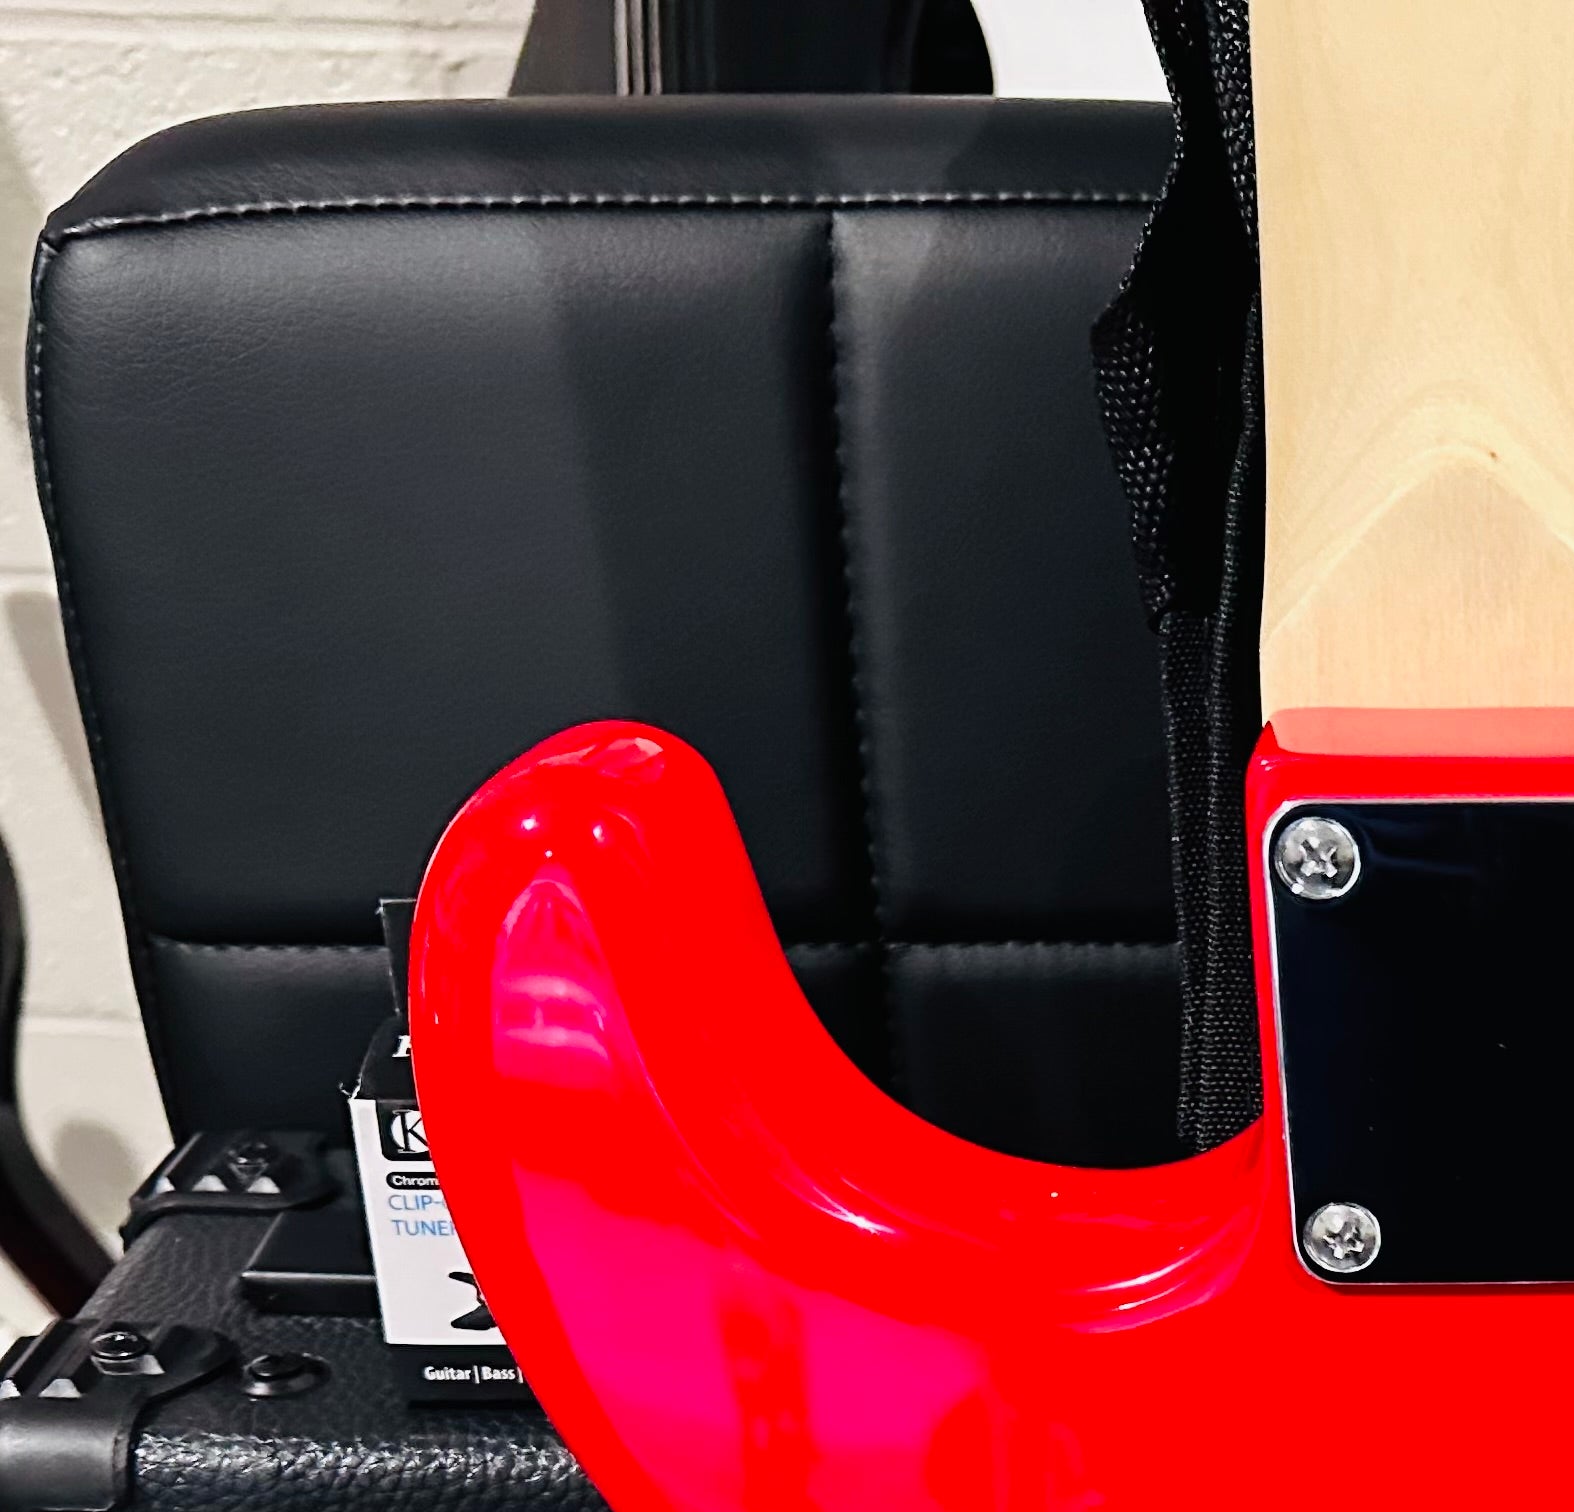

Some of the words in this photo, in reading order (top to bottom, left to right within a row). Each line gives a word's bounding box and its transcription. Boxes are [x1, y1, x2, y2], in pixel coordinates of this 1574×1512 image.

[388, 1194, 446, 1211] CLIP-
[423, 1366, 472, 1381] Guitar
[481, 1366, 516, 1381] Bass
